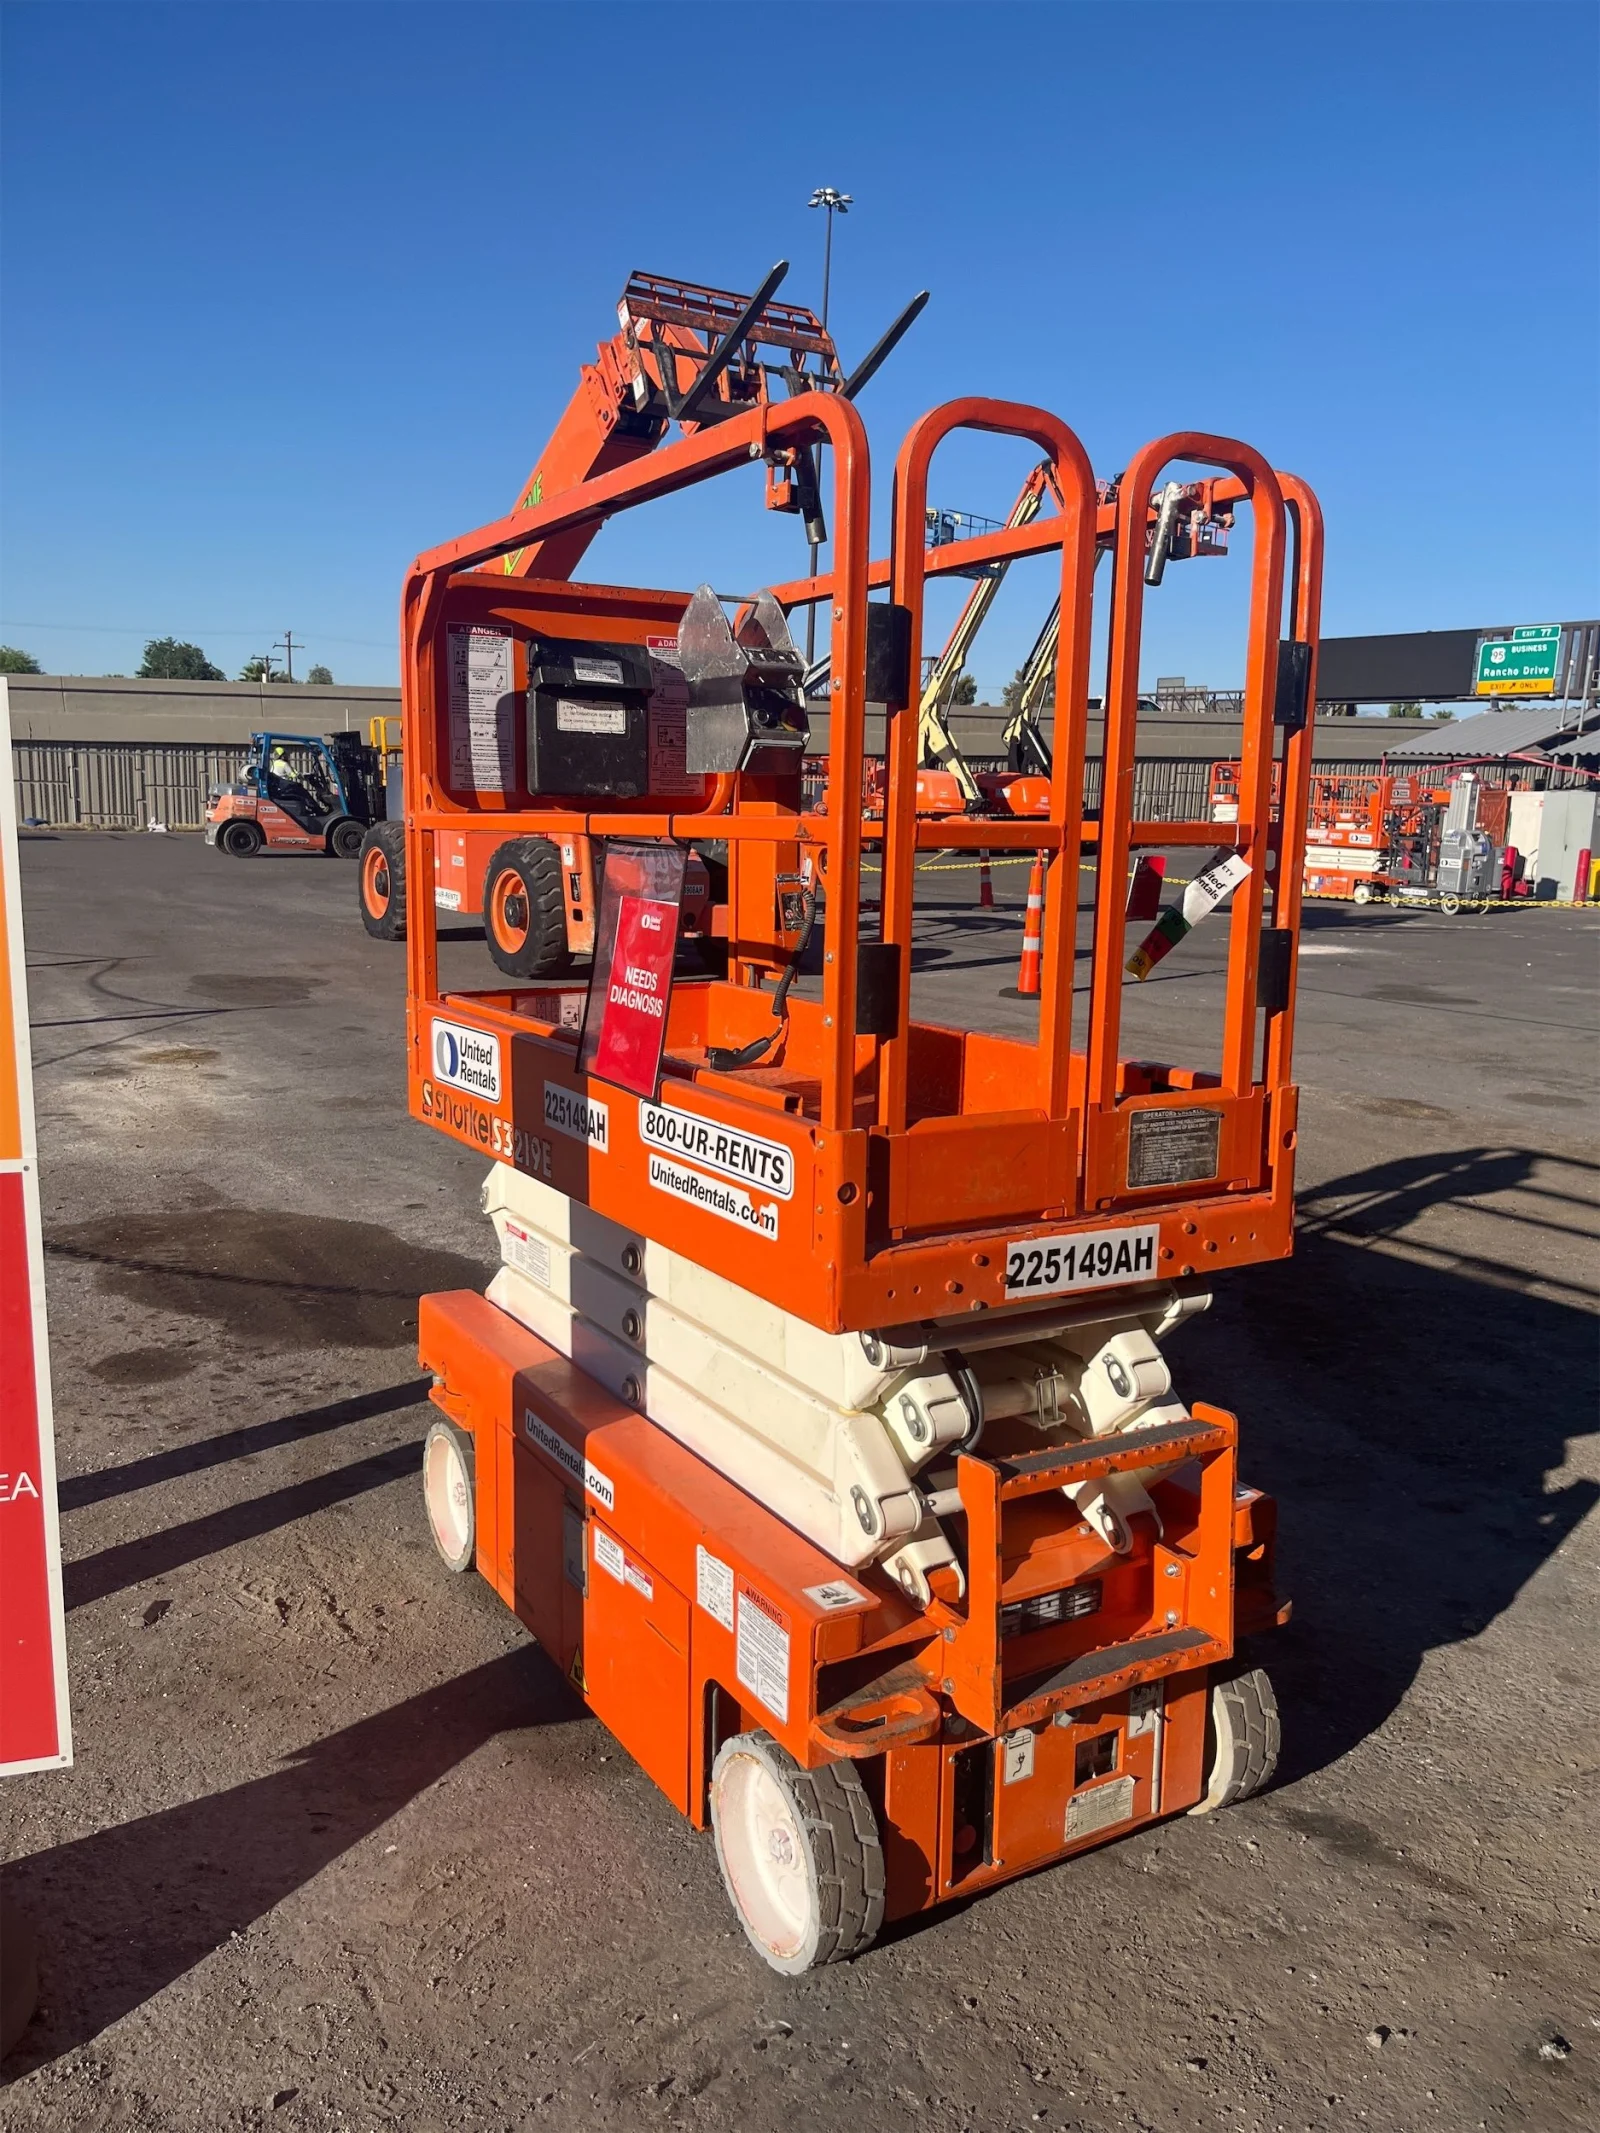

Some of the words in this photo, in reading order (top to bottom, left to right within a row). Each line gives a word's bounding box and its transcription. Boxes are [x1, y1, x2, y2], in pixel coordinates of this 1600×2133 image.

[1511, 644, 1548, 654] BUSINESS
[1522, 630, 1536, 638] EXIT
[1540, 628, 1552, 637] 77
[1483, 667, 1519, 677] Rancho
[1523, 665, 1550, 675] Drive
[1493, 650, 1504, 660] 95
[624, 965, 658, 992] NEEDS
[610, 984, 663, 1018] DIAGNOSIS
[459, 1035, 493, 1067] United
[460, 1060, 497, 1093] Rentals
[545, 1090, 606, 1144] 225149AH
[646, 1110, 785, 1185] 800-UR-RENTS
[651, 1160, 776, 1233] UnitedRentals.com
[1008, 1236, 1154, 1289] 225149AH
[526, 1413, 613, 1505] UnitedRentals.com
[750, 1589, 783, 1625] WARNING
